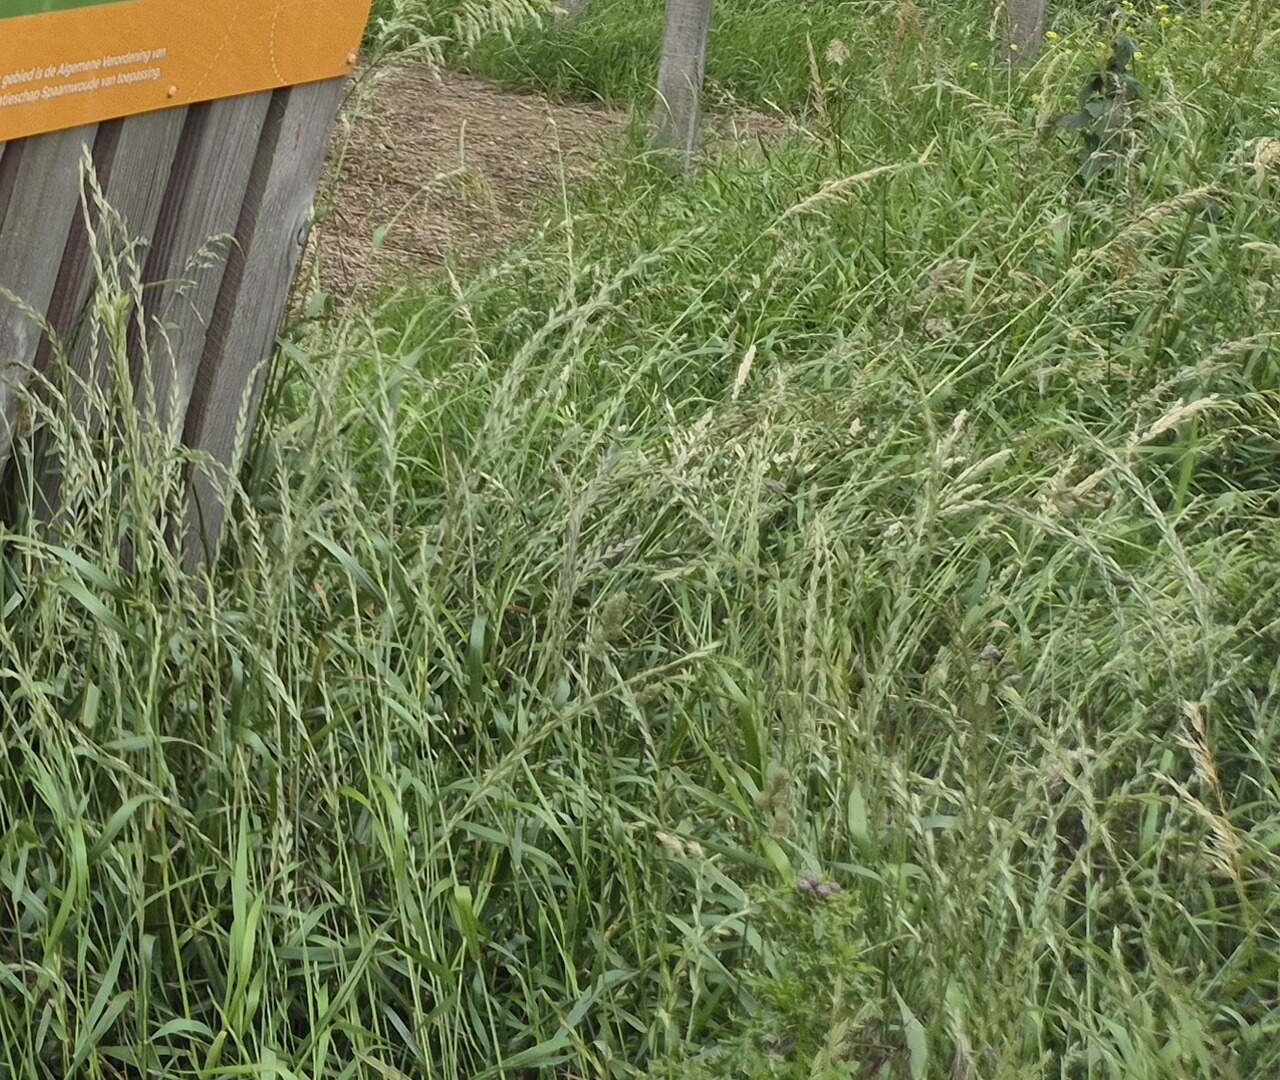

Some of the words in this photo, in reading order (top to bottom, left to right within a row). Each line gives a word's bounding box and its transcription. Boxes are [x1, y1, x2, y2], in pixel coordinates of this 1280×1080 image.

[1, 67, 35, 89] gebied
[42, 63, 56, 78] de
[56, 59, 101, 78] Algemene
[102, 48, 151, 69] Verordening
[151, 47, 167, 60] van
[41, 77, 100, 101] Spaarnwoude
[100, 74, 116, 88] van
